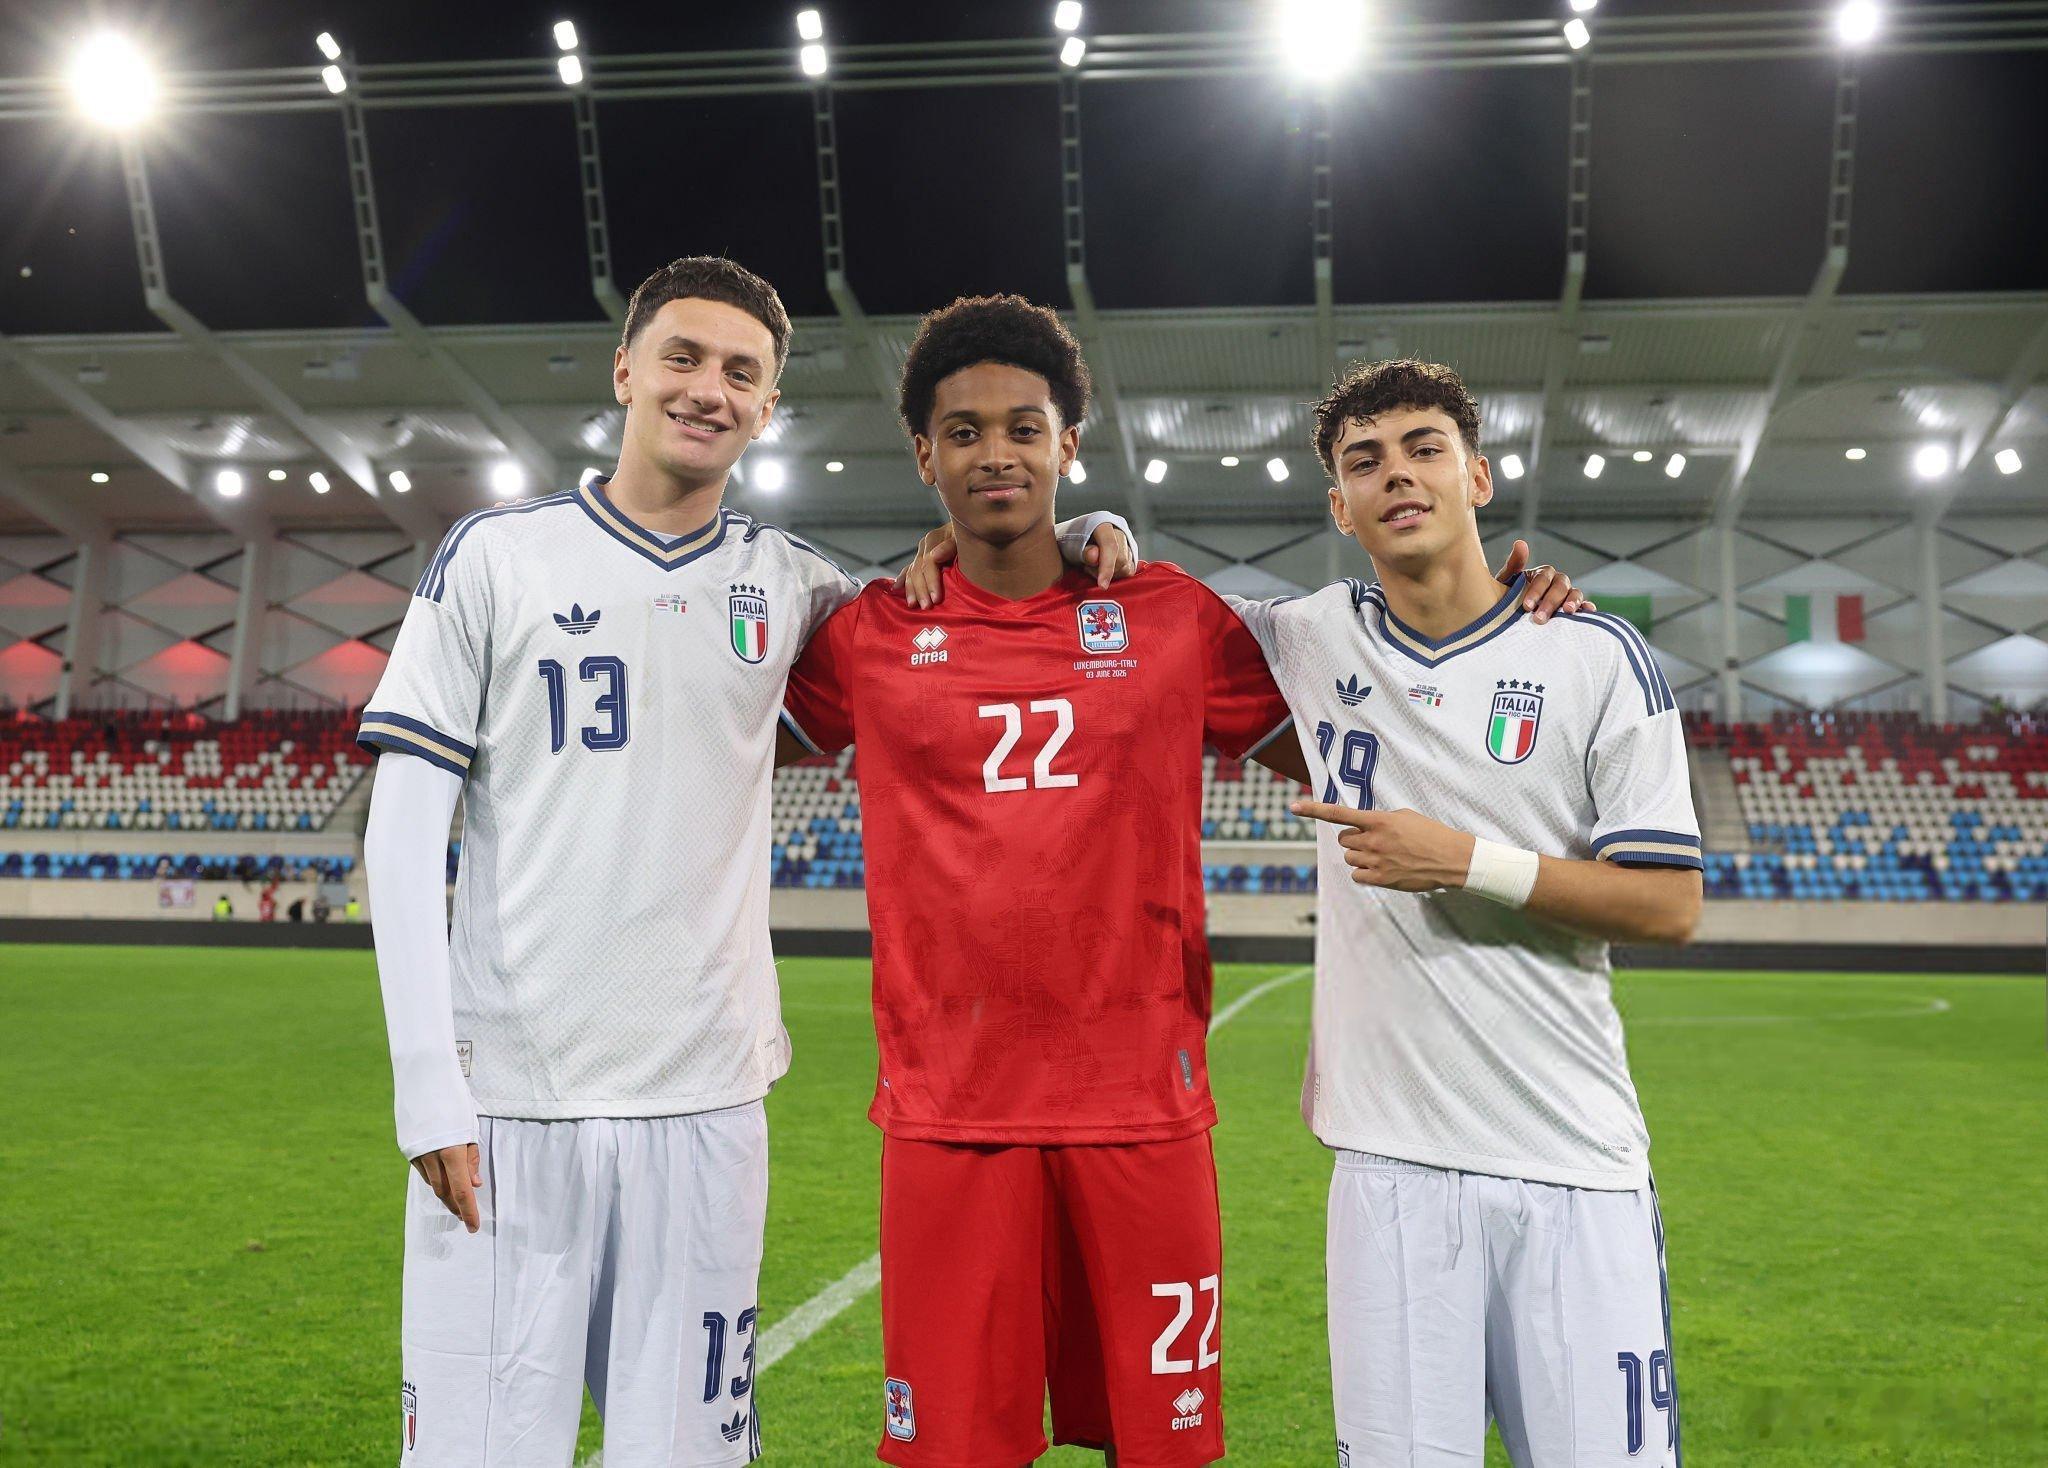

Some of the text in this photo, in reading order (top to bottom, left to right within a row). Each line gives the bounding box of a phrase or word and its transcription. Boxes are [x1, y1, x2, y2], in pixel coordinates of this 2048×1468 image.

[733, 600, 765, 616] ITALIA
[538, 655, 630, 756] 13
[1073, 659, 1138, 671] LUXEMBOURG-ITALY
[1085, 669, 1127, 679] 03 JUNE 2026
[1496, 696, 1537, 714] ITALIA
[978, 698, 1079, 793] 22
[1316, 720, 1381, 811] 19
[703, 1304, 757, 1403] 13
[1151, 1273, 1219, 1375] 22
[1617, 1349, 1674, 1457] 19
